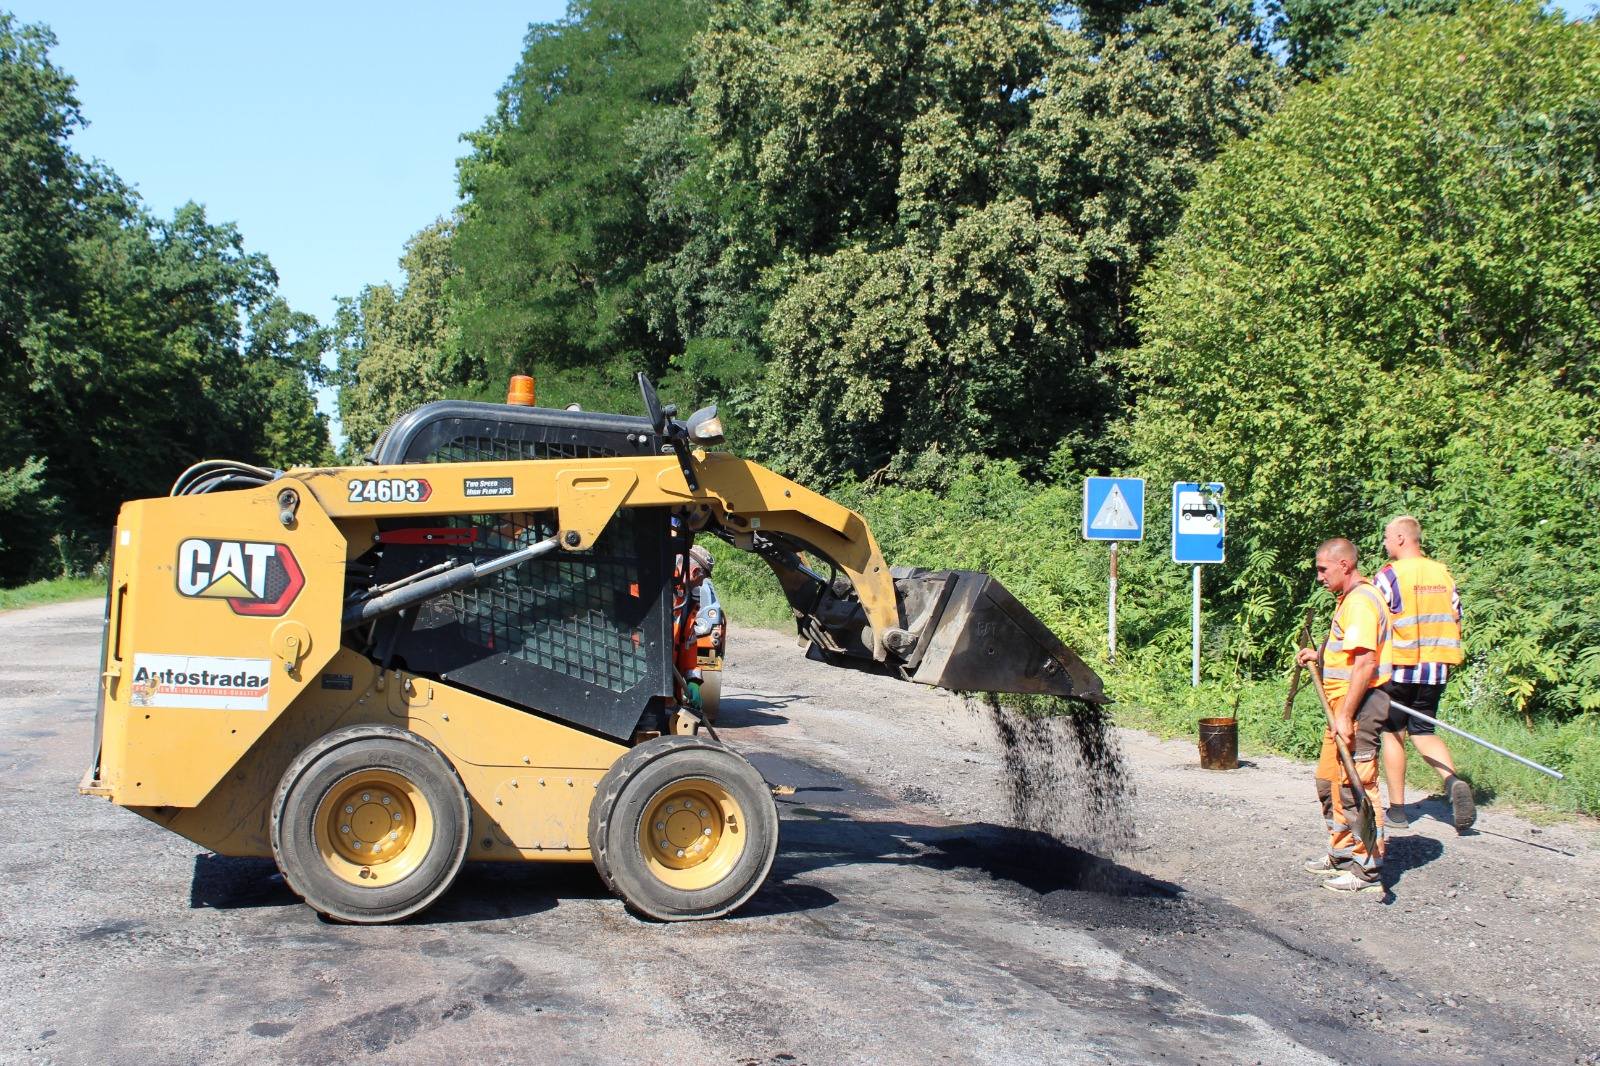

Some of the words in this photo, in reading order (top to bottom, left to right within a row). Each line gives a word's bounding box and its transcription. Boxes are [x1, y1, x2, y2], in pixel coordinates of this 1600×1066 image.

[349, 479, 420, 502] 246D3
[178, 539, 276, 599] CAT
[134, 667, 260, 688] Autostrada
